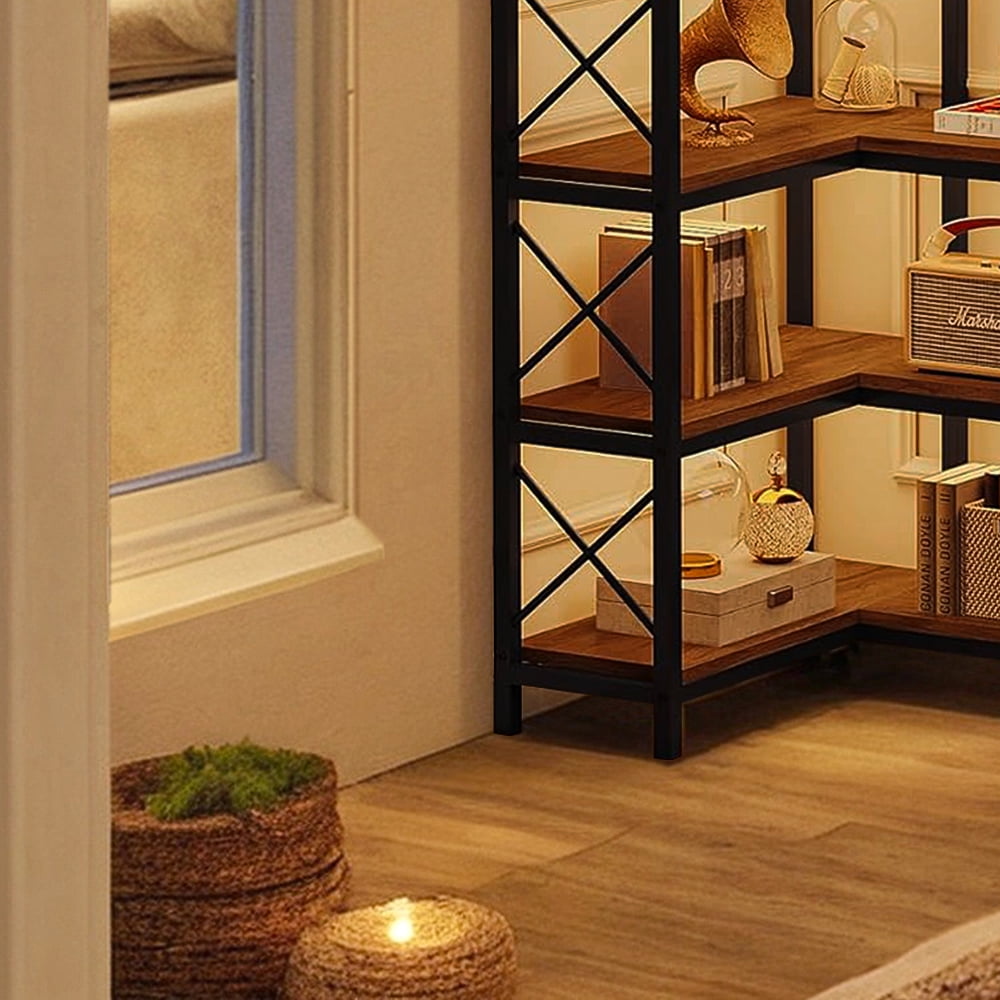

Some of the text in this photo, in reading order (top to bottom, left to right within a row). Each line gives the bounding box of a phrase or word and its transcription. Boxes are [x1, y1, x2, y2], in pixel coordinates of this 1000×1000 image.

[920, 514, 932, 558] DOYLE
[940, 518, 951, 561] DOYLE
[920, 563, 932, 612] CONAN
[940, 566, 951, 614] CONAN
